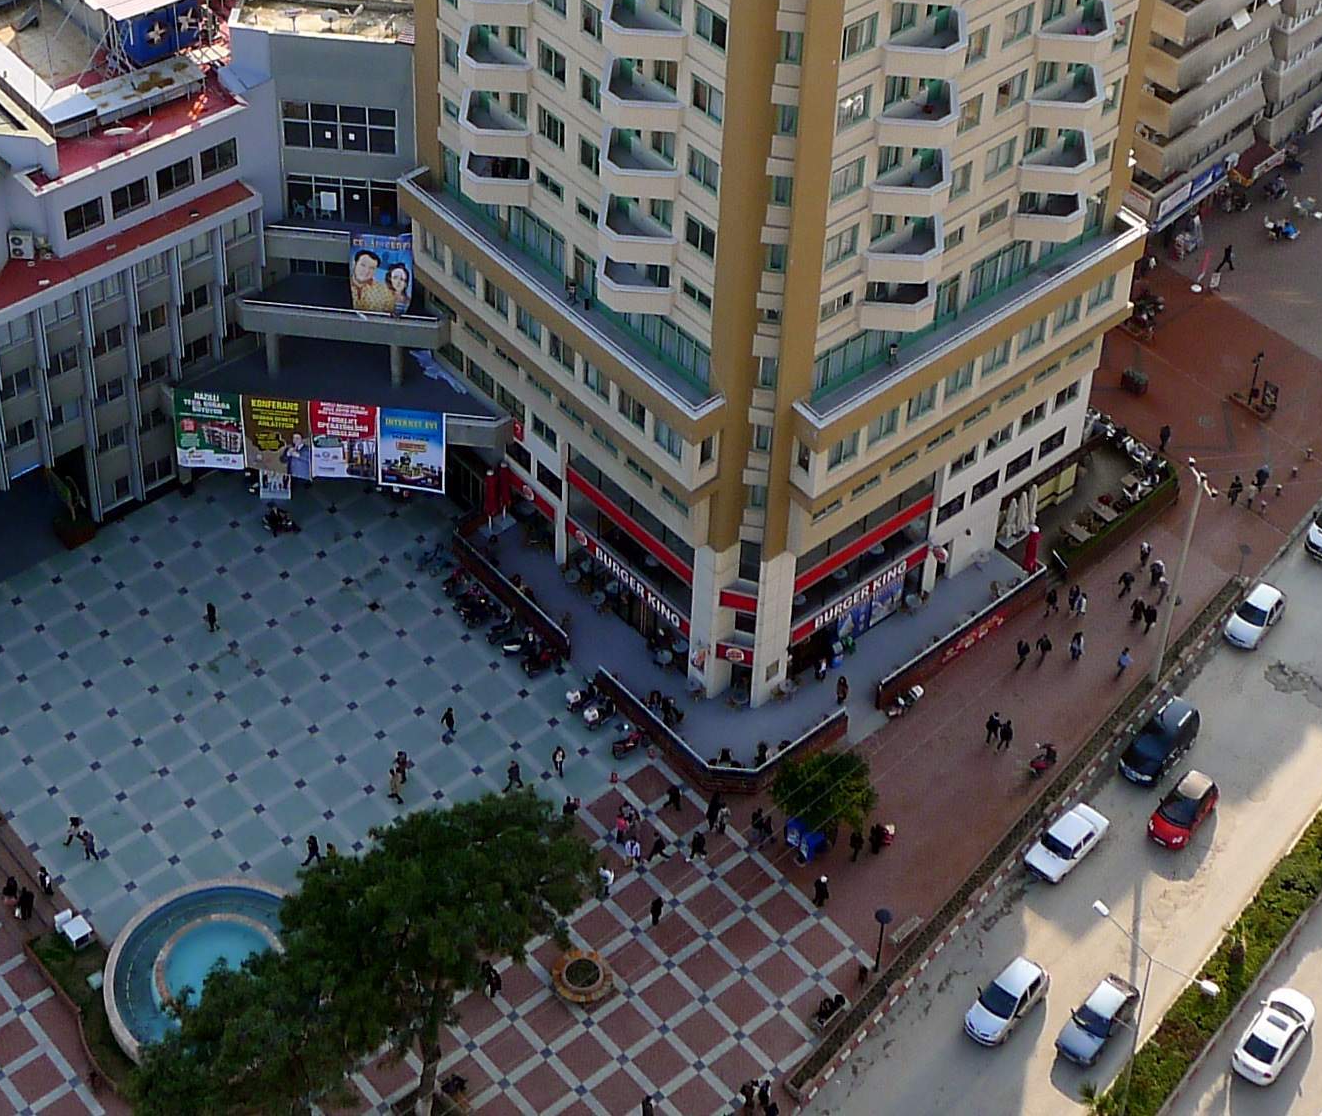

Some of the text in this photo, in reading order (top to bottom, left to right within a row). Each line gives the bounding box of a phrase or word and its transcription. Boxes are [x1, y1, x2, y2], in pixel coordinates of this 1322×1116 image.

[595, 546, 681, 628] BURGER KING
[814, 560, 908, 629] BURGER KING
